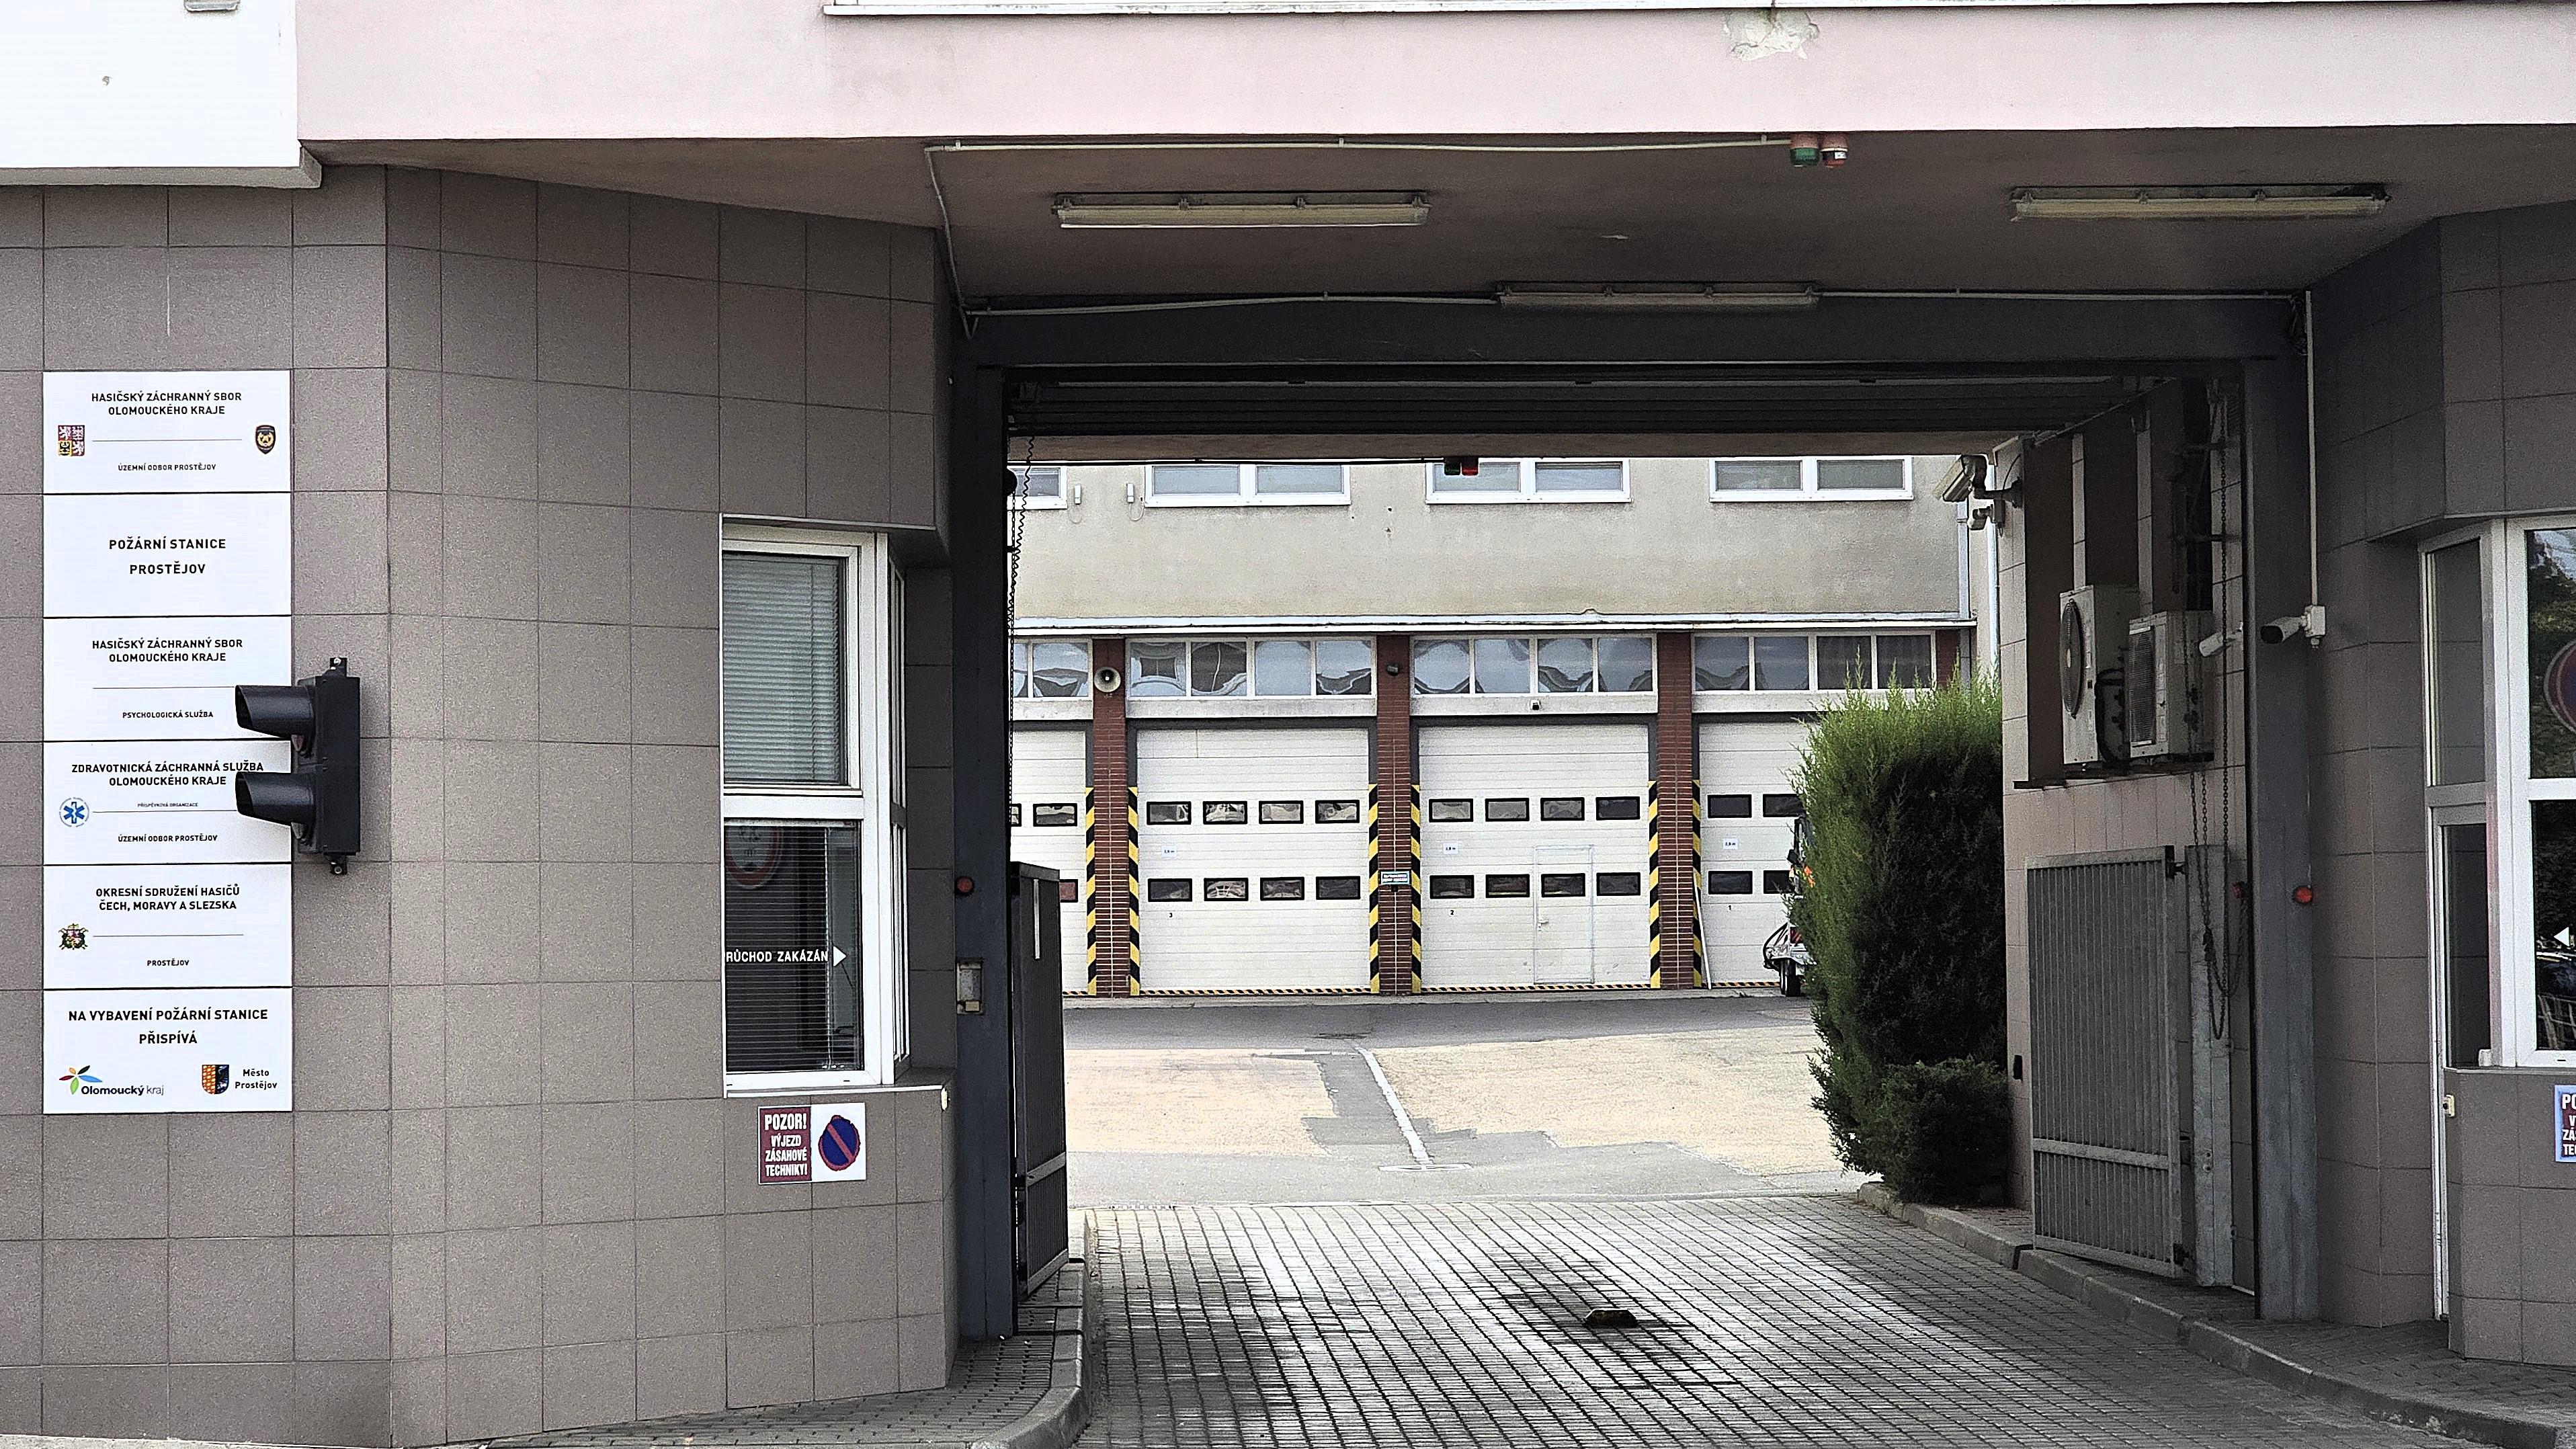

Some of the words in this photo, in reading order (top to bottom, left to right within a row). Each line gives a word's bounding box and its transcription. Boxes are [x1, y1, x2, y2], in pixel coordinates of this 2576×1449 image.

[92, 390, 144, 401] HASIČSKÝ
[147, 390, 211, 401] ZÁCHRANNÝ
[214, 392, 241, 401] SBOR
[109, 404, 188, 415] OLOMOUCKÉHO
[191, 406, 224, 414] KRAJE
[110, 536, 166, 549] POŽÁRNÍ
[170, 539, 226, 549] STANICE
[130, 561, 205, 574] PROSTĚJOV
[93, 637, 144, 649] HASIČSKÝ
[147, 636, 212, 648] ZÁCHRANNÝ
[215, 639, 243, 647] SBOR
[110, 651, 188, 662] OLOMOUCKÉHO
[192, 653, 226, 661] KRAJE
[123, 710, 183, 718] PSYCHOLOGICKÁ
[185, 710, 213, 718] SLUŽBA
[72, 761, 153, 772] ZDRAVOTNICKÁ
[155, 760, 220, 772] ZÁCHRANNÁ
[222, 759, 263, 771] SLUŽBA
[110, 774, 189, 786] OLOMOUCKÉHO
[192, 776, 226, 785] KRAJE
[175, 833, 218, 841] PROSTĚJOV
[96, 886, 142, 897] OKRESNÍ
[145, 885, 198, 896] SDRUŽENÍ
[201, 884, 239, 896] HASIČŮ
[99, 899, 130, 911] ČECH,
[134, 901, 177, 910] MORAVY
[179, 901, 187, 909] A
[190, 901, 237, 909] SLEZSKA
[726, 949, 772, 962] RŮCHOD
[778, 948, 828, 963] ZAKÁZÁN
[69, 1011, 86, 1021] NA
[89, 1007, 153, 1020] VYBAVENÍ
[157, 1007, 211, 1020] POŽÁRNÍ
[214, 1009, 267, 1020] STANICE
[139, 1030, 197, 1044] PŘISPÍVÁ
[243, 1069, 269, 1077] Město
[81, 1085, 144, 1095] Olomoucký
[147, 1085, 164, 1095] kraj
[235, 1081, 277, 1090] Prostějov
[765, 1113, 806, 1130] POZOR!
[771, 1133, 802, 1147] VÝJEZD
[765, 1146, 807, 1161] ZÁSAHOVÉ
[765, 1163, 807, 1176] TECHNIKY!
